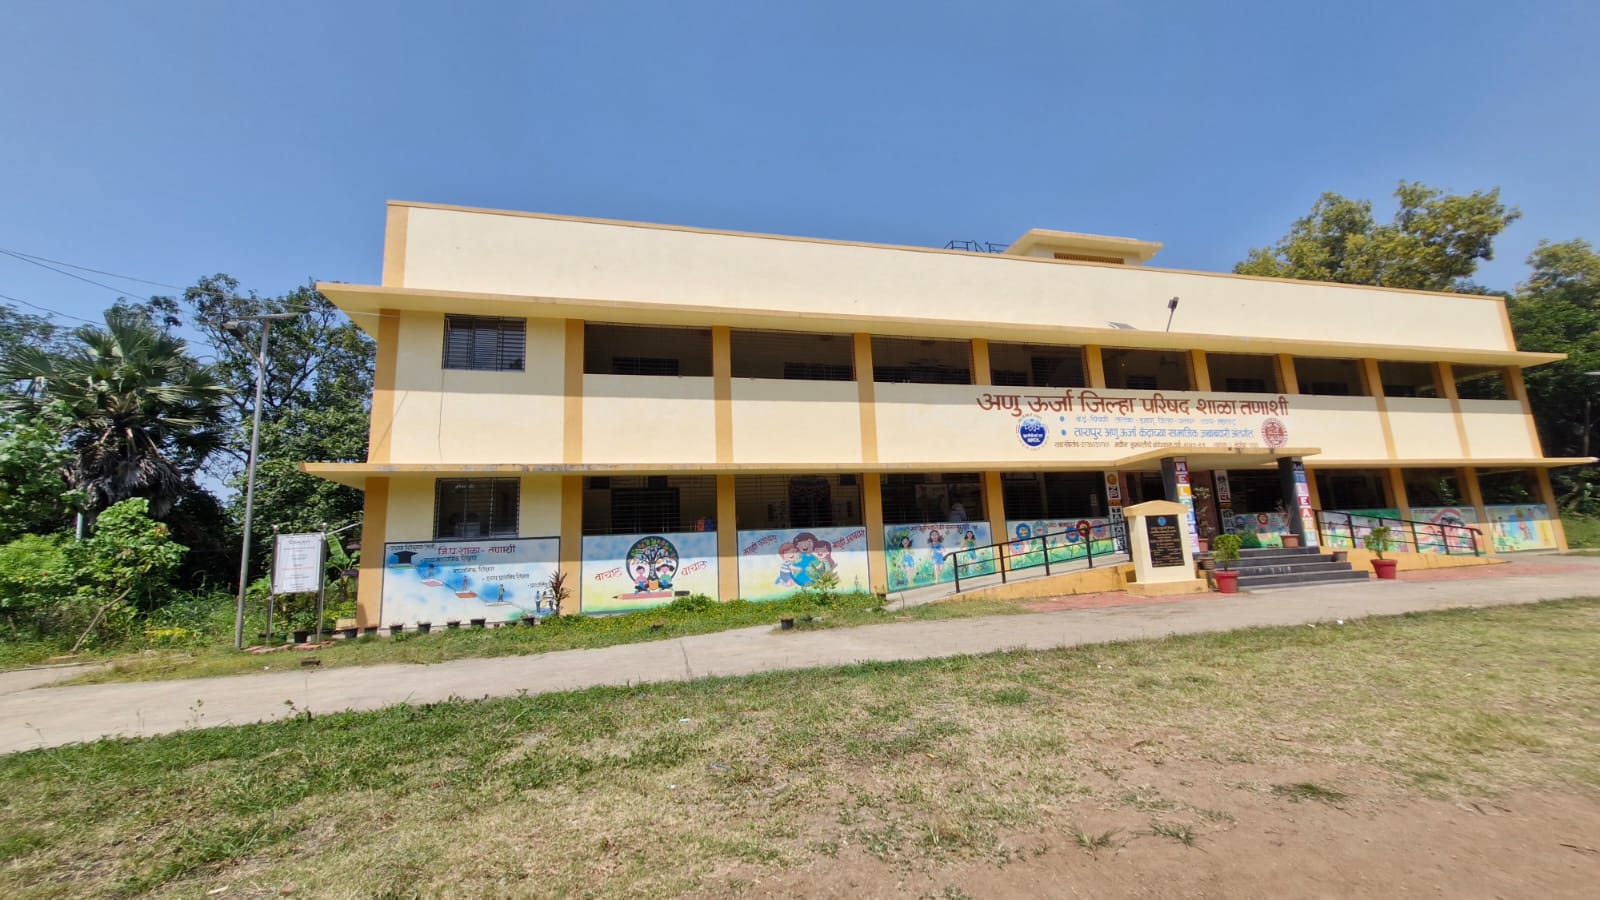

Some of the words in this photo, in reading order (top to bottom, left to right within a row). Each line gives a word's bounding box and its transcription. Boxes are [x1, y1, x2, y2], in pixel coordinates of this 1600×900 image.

[976, 393, 1022, 417] अणु
[1024, 389, 1074, 413] ऊर्जा
[1077, 390, 1137, 416] जिल्हा
[1139, 392, 1190, 415] परिषद
[1196, 398, 1237, 415] शाळा
[1239, 395, 1289, 416] तणाशी
